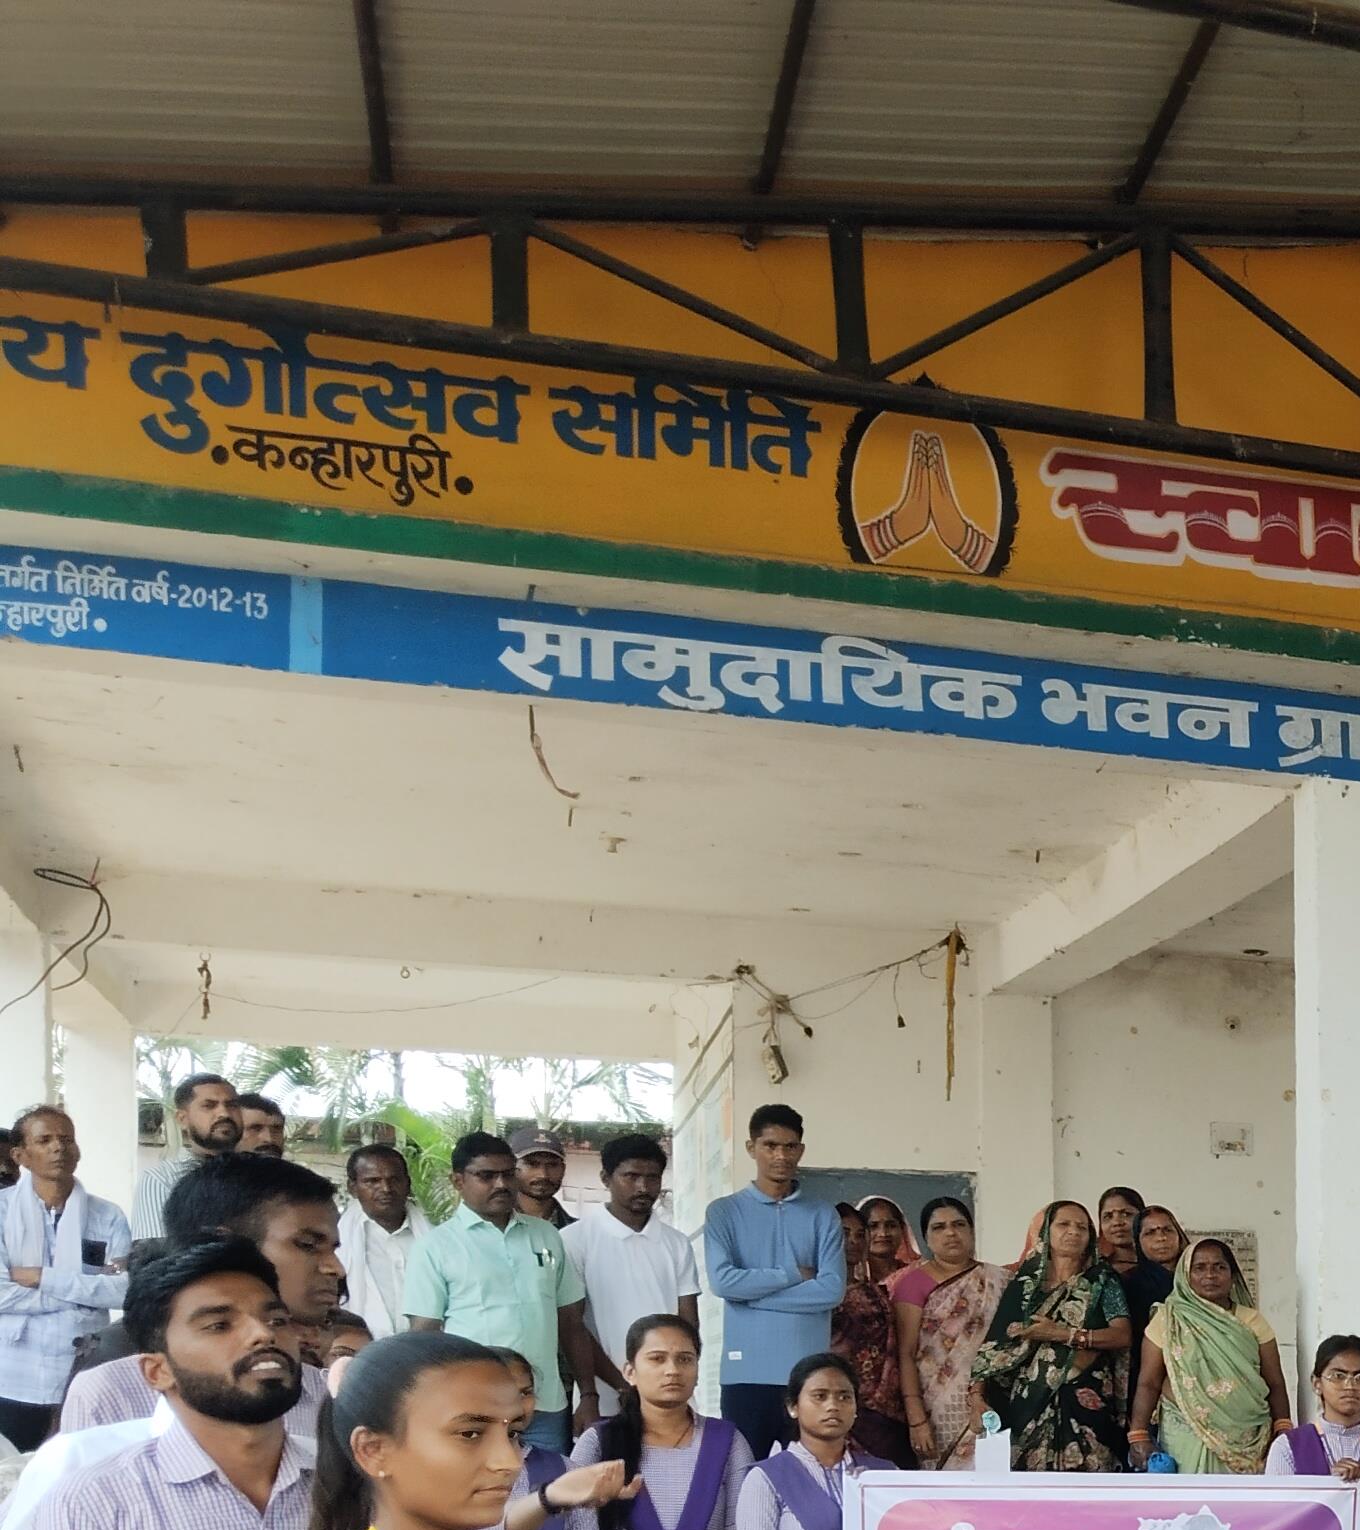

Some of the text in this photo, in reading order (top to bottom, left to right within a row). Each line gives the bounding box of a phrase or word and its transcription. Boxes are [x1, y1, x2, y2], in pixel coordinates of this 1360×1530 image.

[224, 422, 452, 507] कन्हारपुरी
[0, 555, 51, 593] तर्गत
[55, 559, 129, 601] निर्मित
[0, 597, 91, 638] हारपुरी
[497, 617, 1022, 720] सामुदायिक
[1040, 678, 1260, 749] भवन
